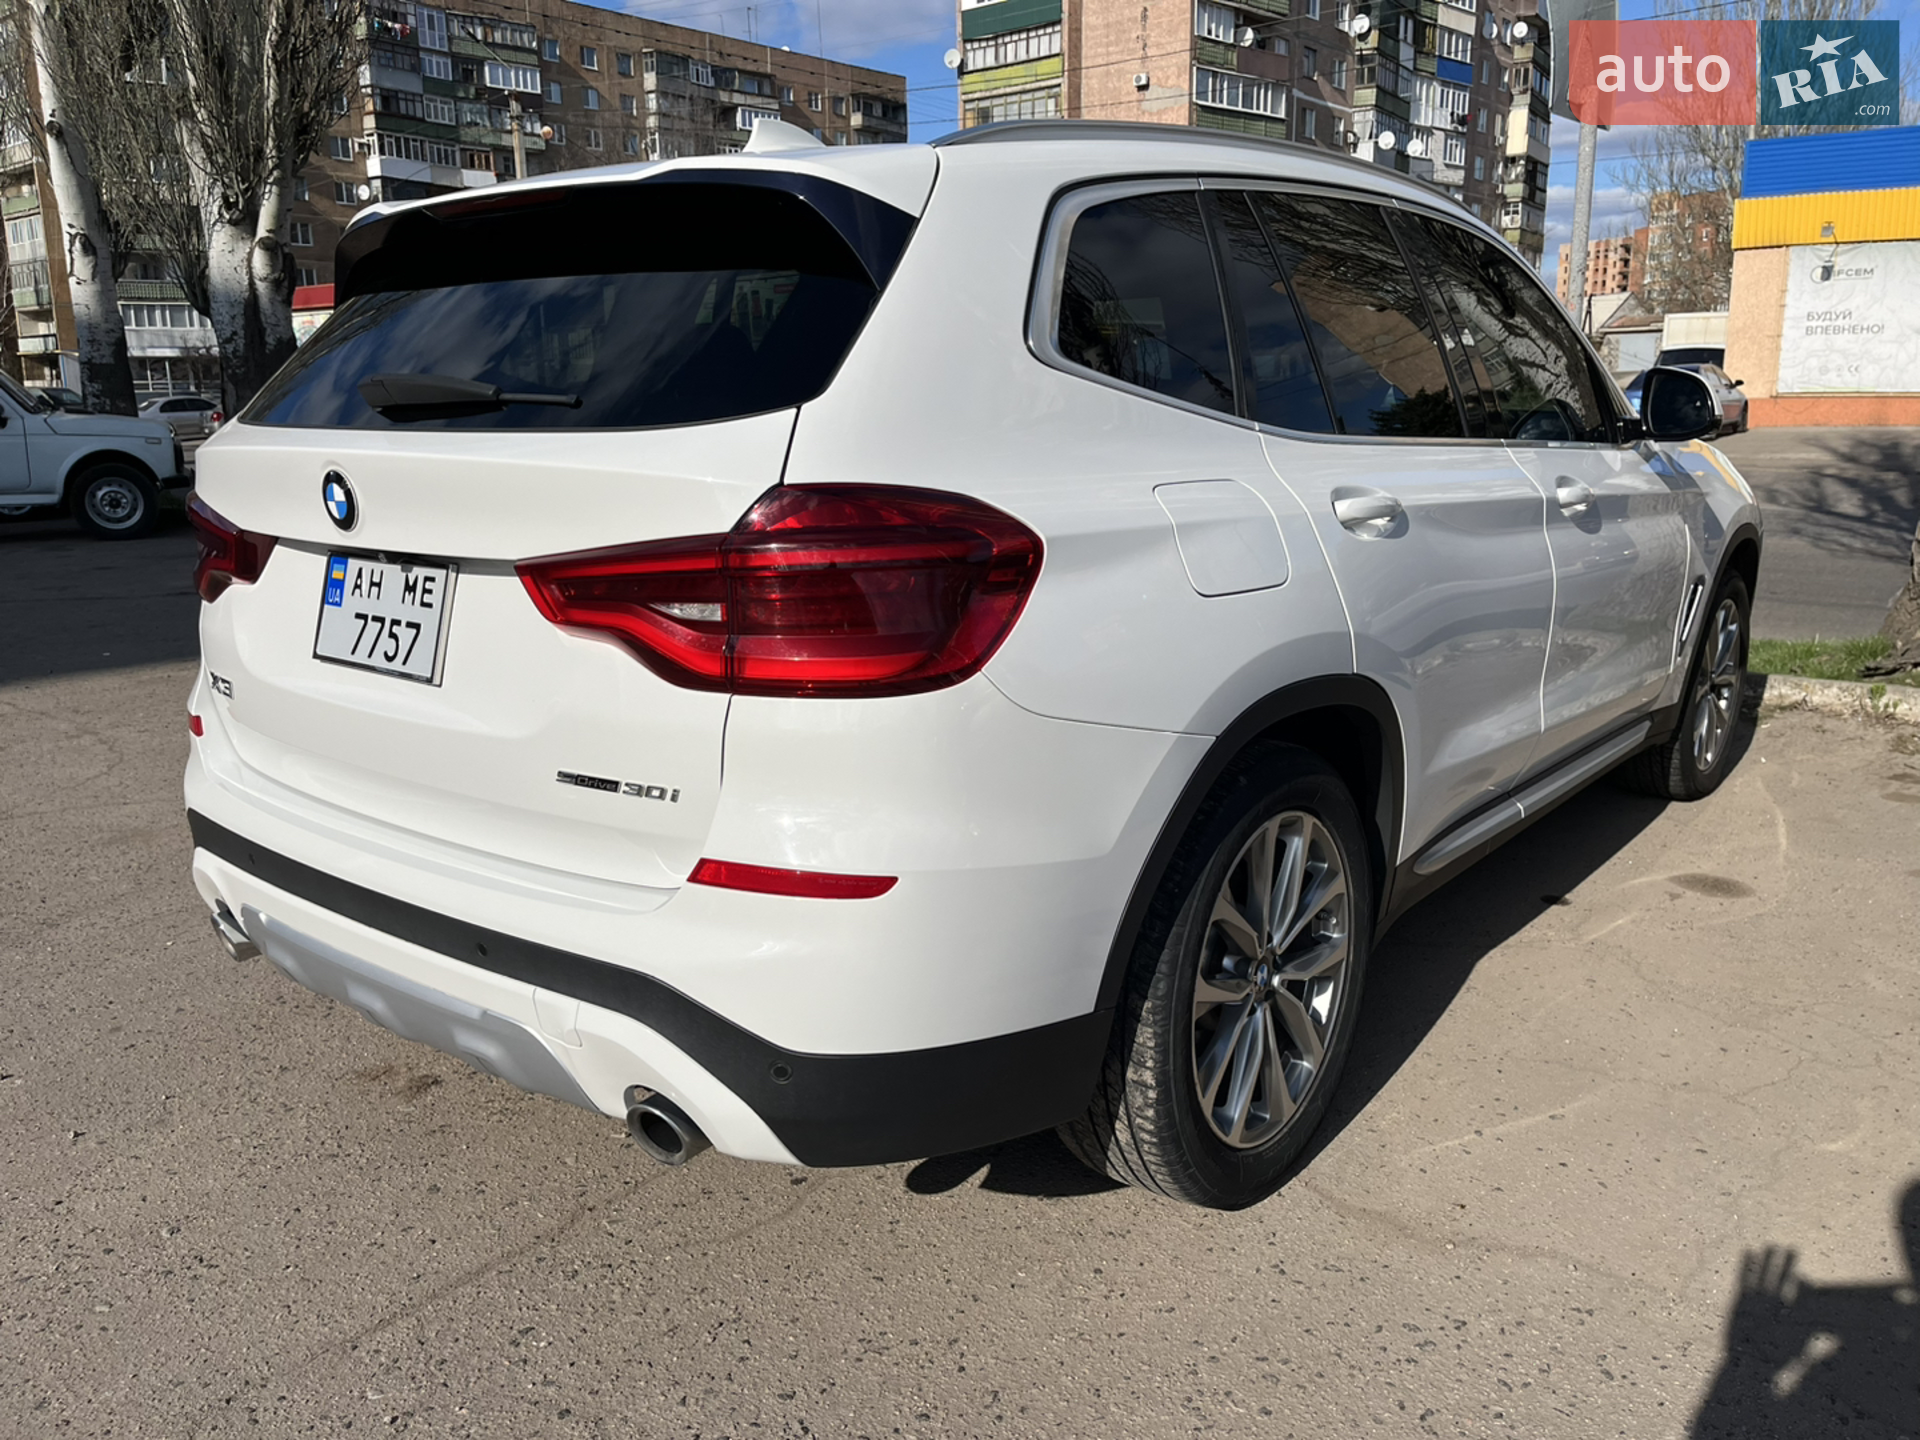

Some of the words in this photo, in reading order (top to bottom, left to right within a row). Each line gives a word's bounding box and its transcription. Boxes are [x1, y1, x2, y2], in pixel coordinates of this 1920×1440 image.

[1806, 309, 1853, 323] БУДУЙ
[1805, 323, 1885, 336] ВПЕВНЕНО!
[327, 587, 342, 604] UA
[351, 566, 384, 600] AH
[401, 573, 437, 609] ME
[350, 612, 422, 666] 7757
[210, 671, 235, 700] X3
